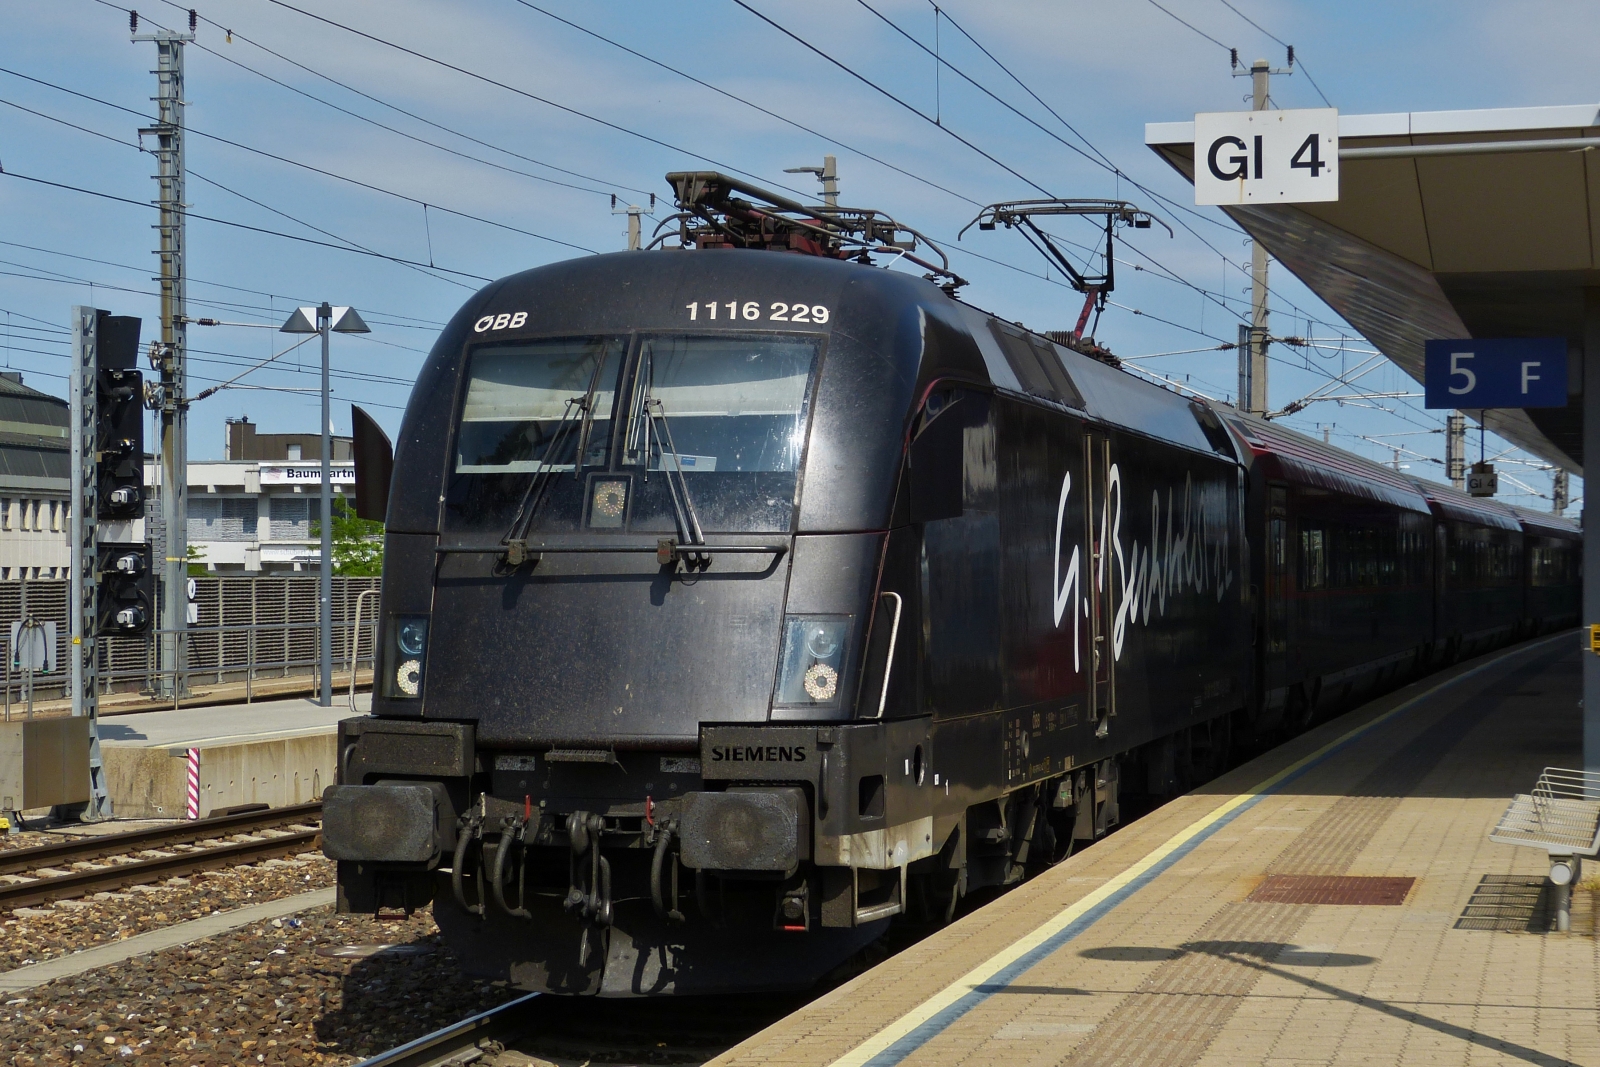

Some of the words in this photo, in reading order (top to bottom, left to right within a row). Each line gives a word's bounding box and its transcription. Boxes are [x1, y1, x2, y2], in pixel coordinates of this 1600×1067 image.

[1290, 133, 1326, 178] 4
[686, 301, 760, 321] 1116
[769, 302, 830, 324] 229
[1448, 352, 1476, 395] 5
[1521, 361, 1541, 394] F
[287, 468, 355, 478] Baumartn
[1487, 478, 1495, 488] 4
[711, 746, 807, 762] SIEMENS
